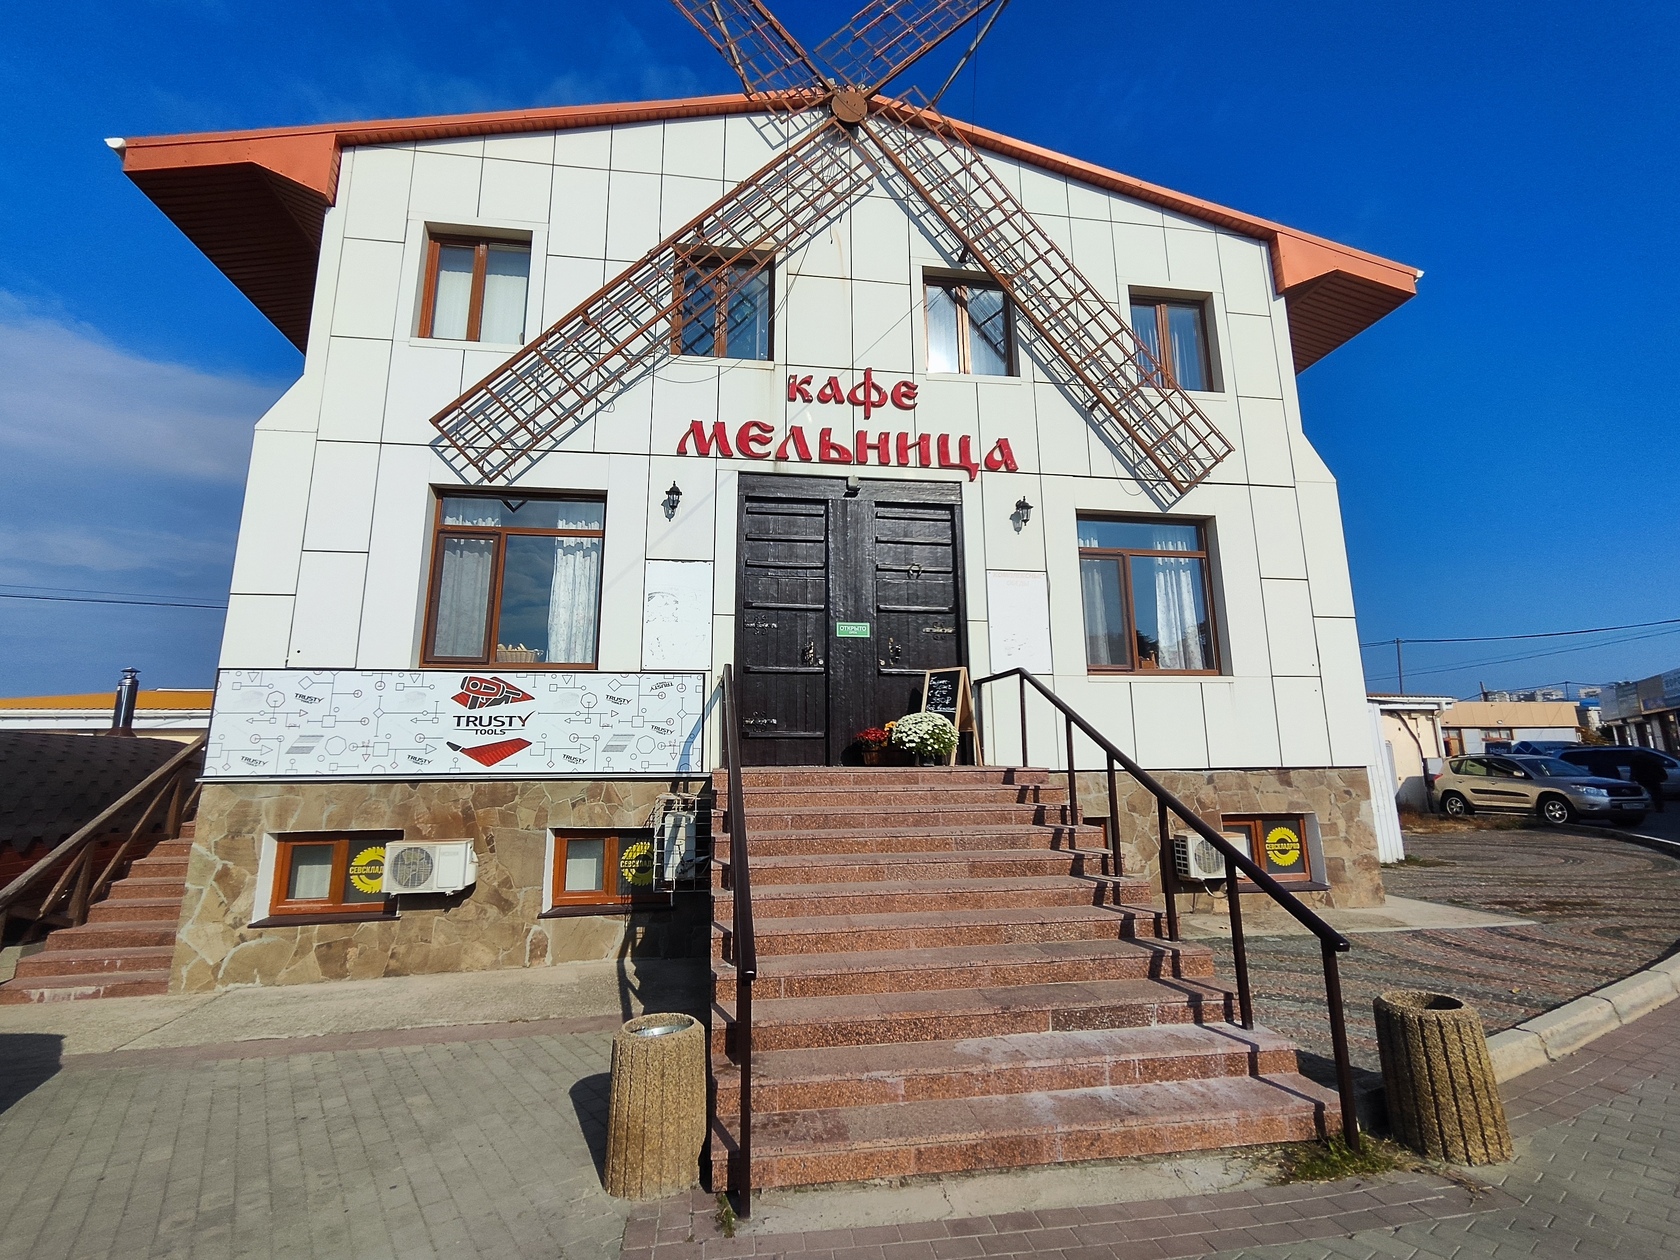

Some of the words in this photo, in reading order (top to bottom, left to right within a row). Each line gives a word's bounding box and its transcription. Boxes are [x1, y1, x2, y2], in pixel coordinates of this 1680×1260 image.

[676, 420, 1019, 481] МЕЛЬНИЦА
[294, 693, 325, 704] TRUSTY
[605, 694, 633, 705] TRUSTY
[453, 710, 536, 727] TRUSTY
[651, 725, 675, 735] TRUSTY
[241, 756, 269, 766] TRUSTY
[407, 754, 434, 765] TRUSTY
[562, 753, 588, 764] TRUSTY
